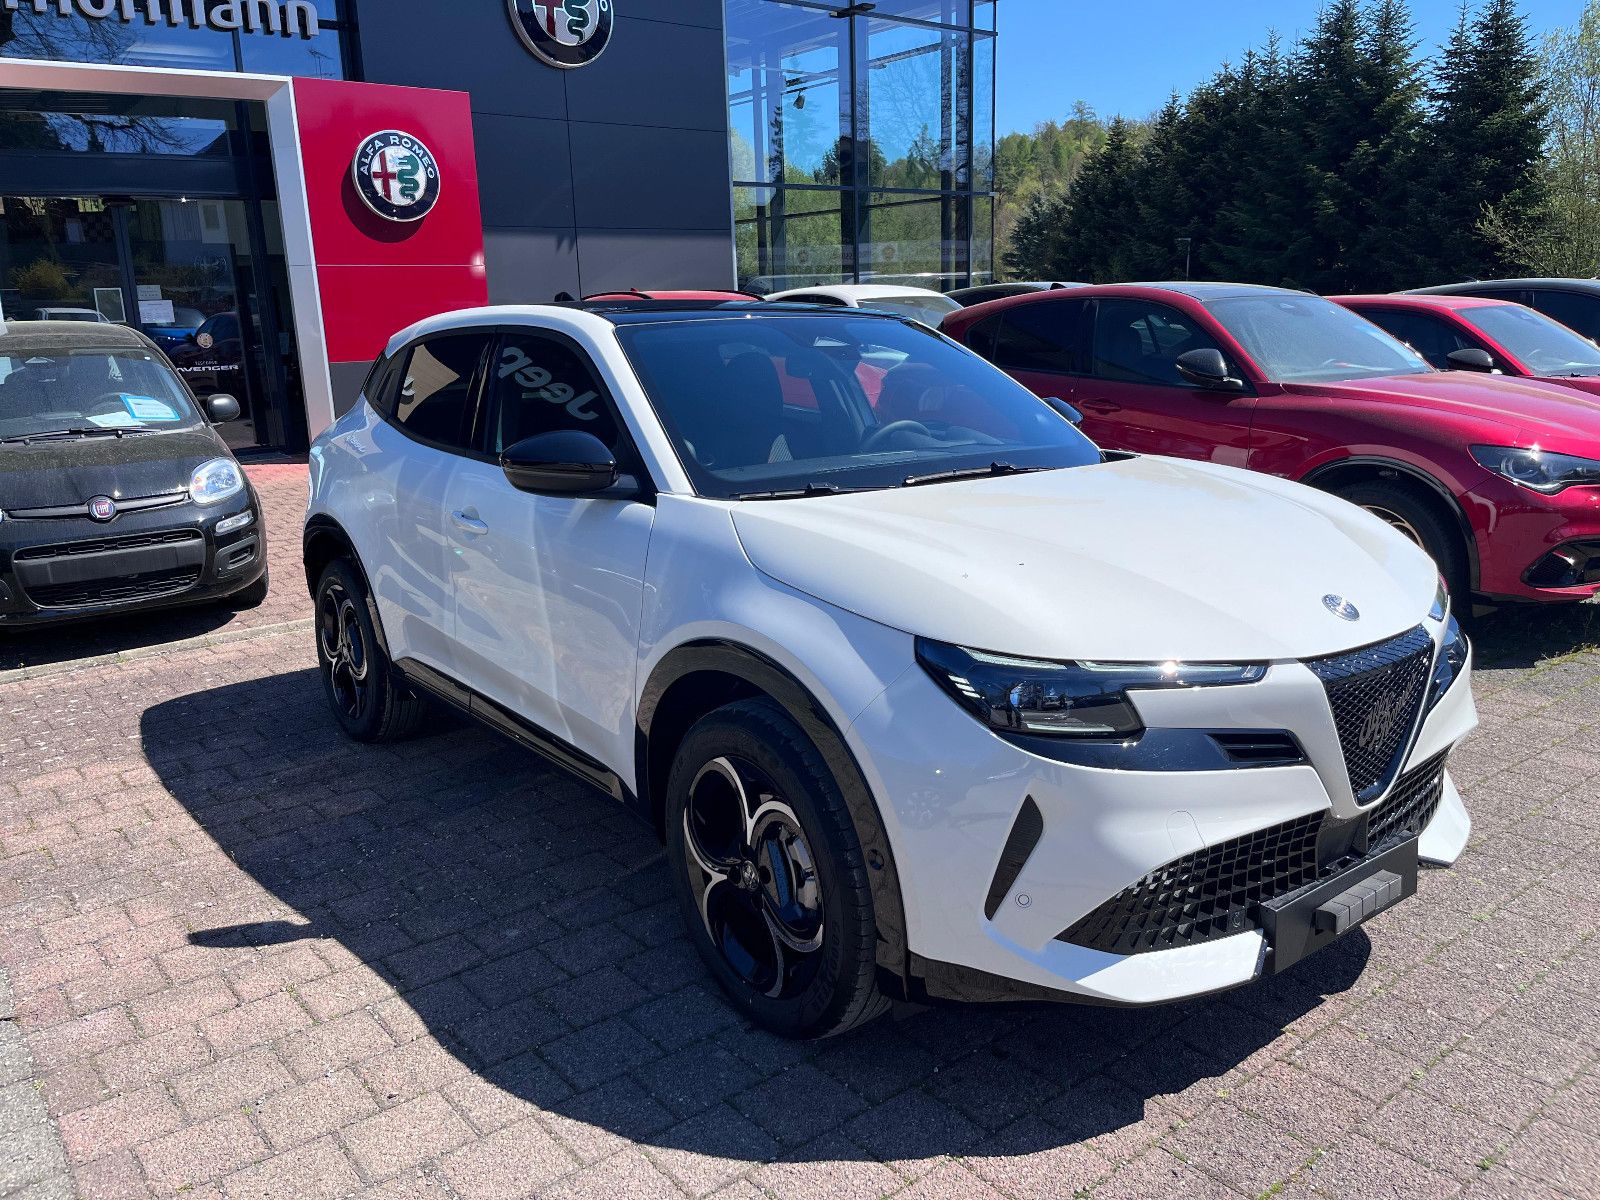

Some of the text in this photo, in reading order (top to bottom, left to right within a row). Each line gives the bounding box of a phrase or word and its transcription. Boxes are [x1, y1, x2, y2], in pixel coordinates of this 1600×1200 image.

[360, 135, 435, 178] ALFA ROMEO
[96, 504, 109, 513] FIAT
